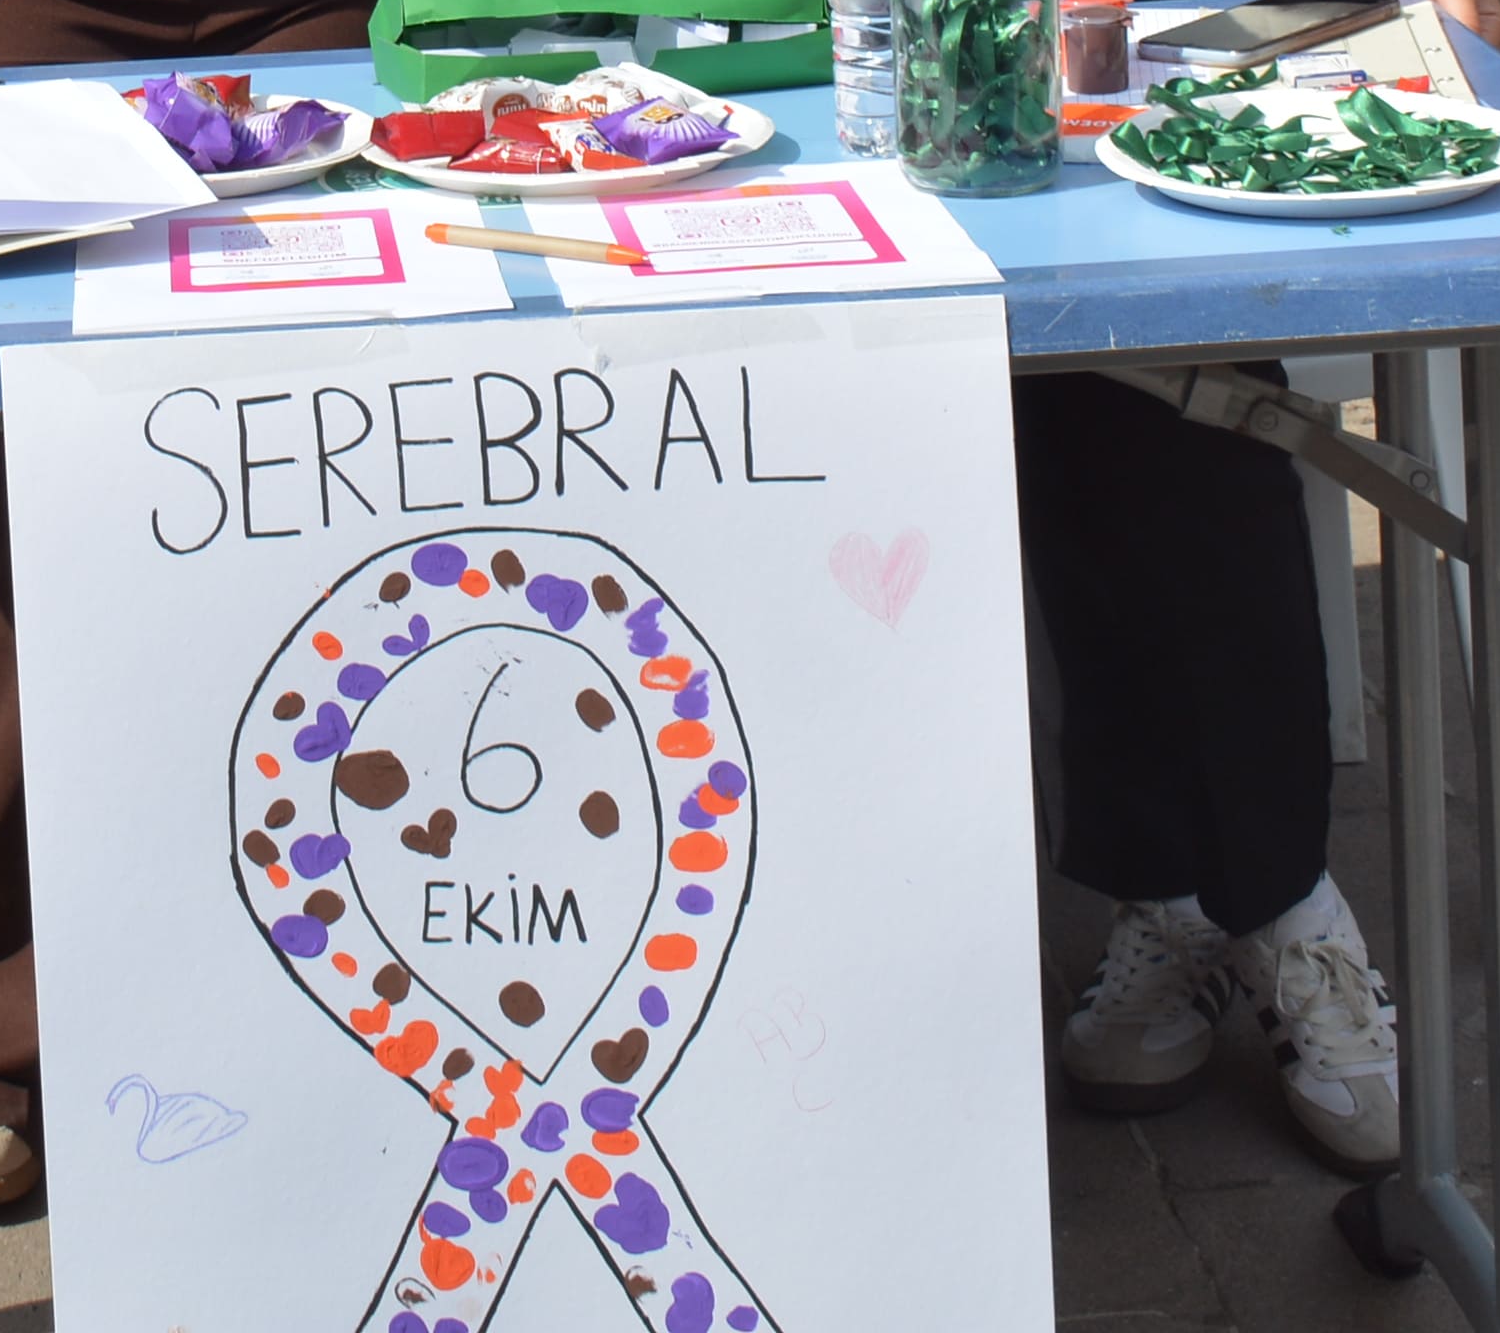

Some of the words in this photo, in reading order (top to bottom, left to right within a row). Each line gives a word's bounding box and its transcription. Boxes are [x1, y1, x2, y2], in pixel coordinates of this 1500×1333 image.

[144, 366, 827, 555] SEREBRAL
[460, 661, 543, 813] 6
[421, 872, 588, 947] EKİM
